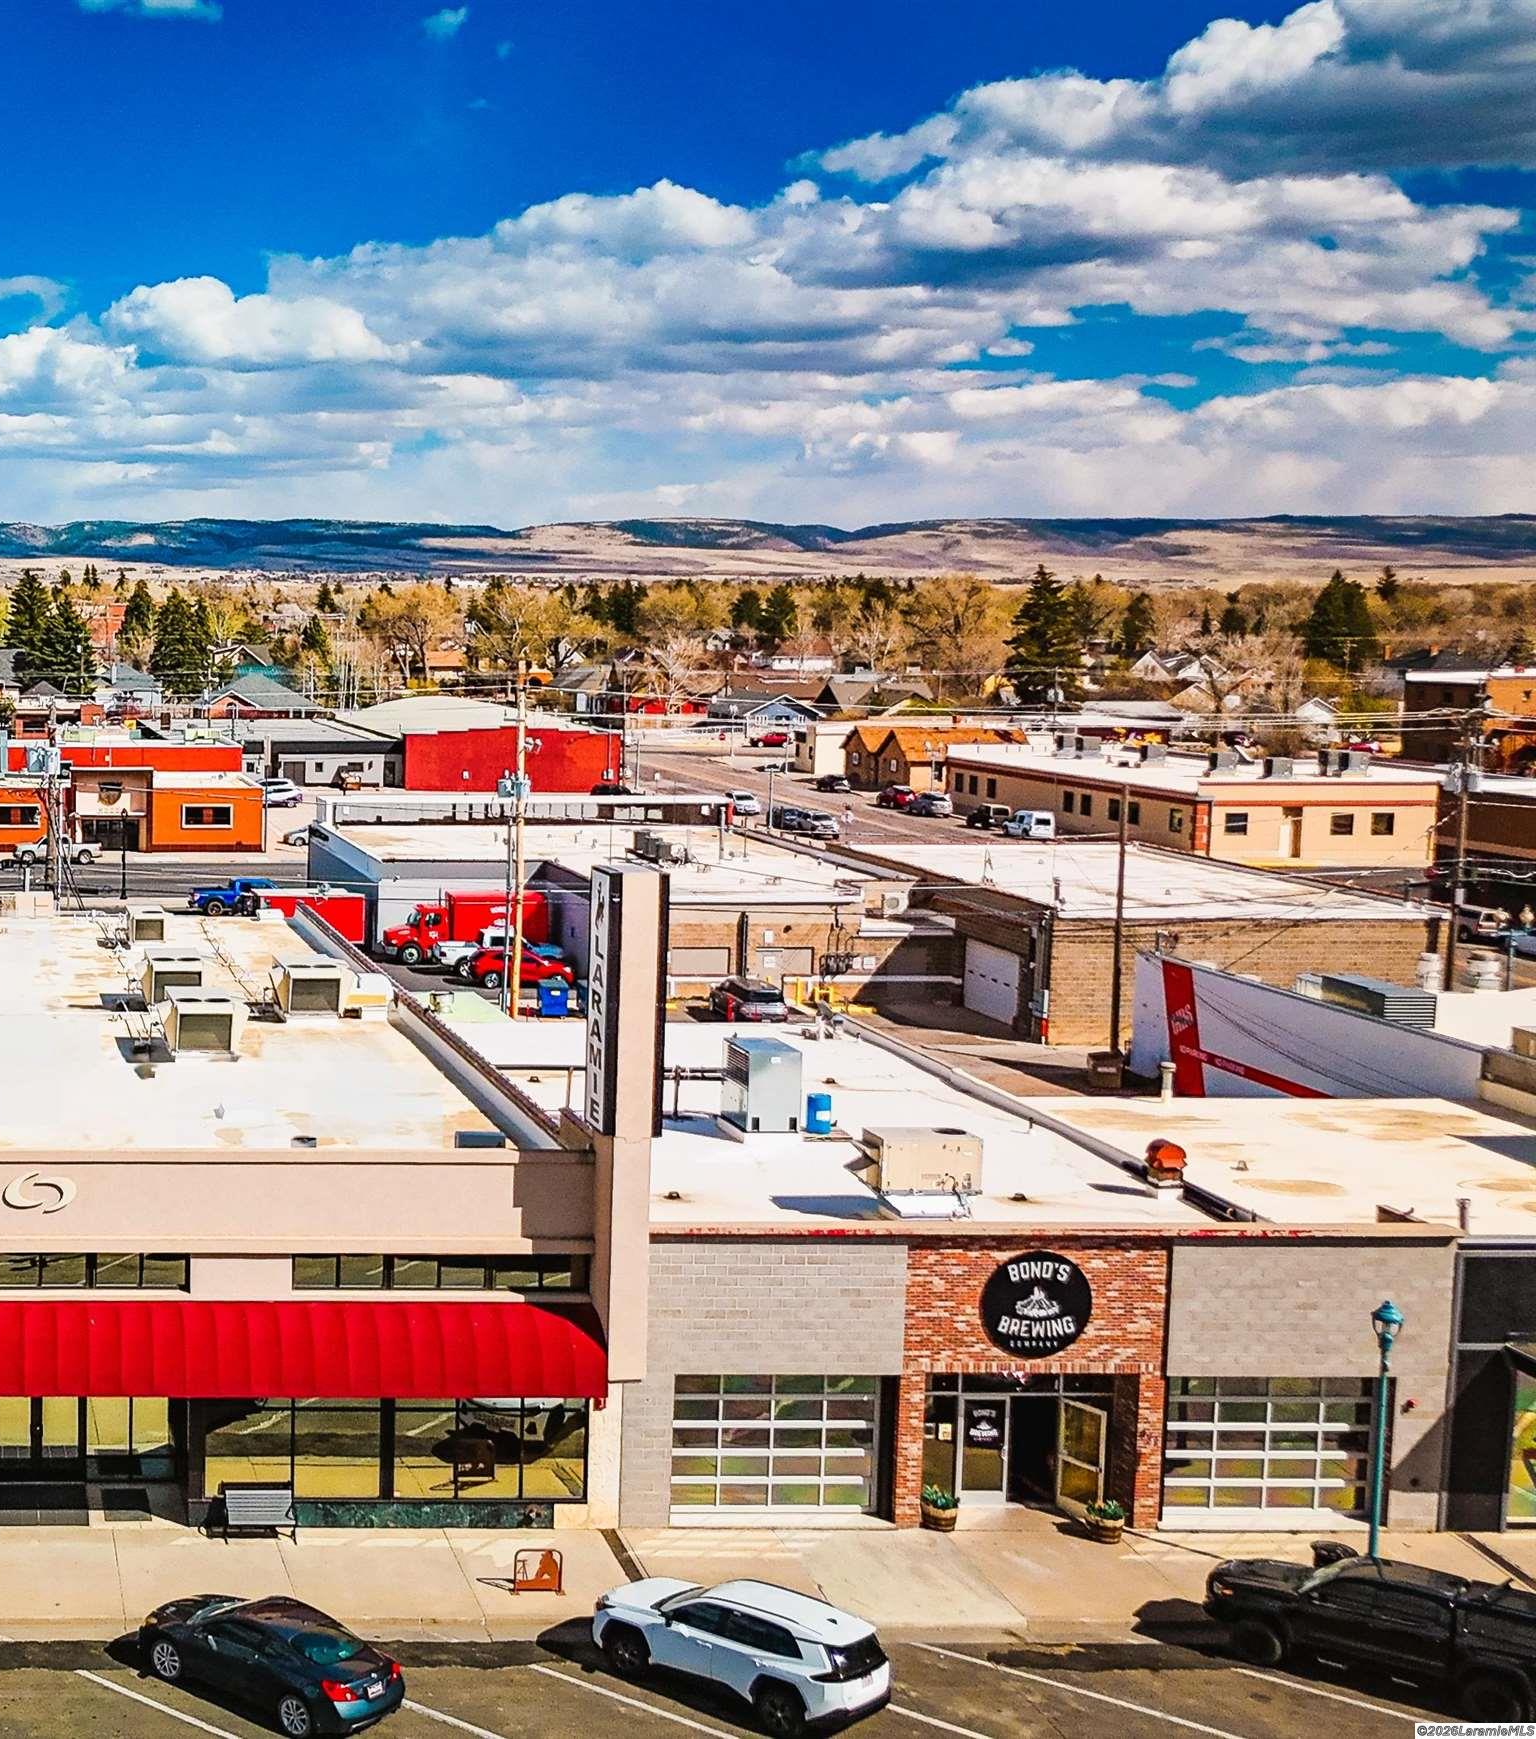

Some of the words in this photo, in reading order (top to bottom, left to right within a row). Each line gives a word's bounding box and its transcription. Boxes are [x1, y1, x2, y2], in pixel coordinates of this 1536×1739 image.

[589, 934, 604, 1126] LARAMIE
[1007, 1261, 1071, 1283] BOND'S
[997, 1315, 1076, 1338] BREWING
